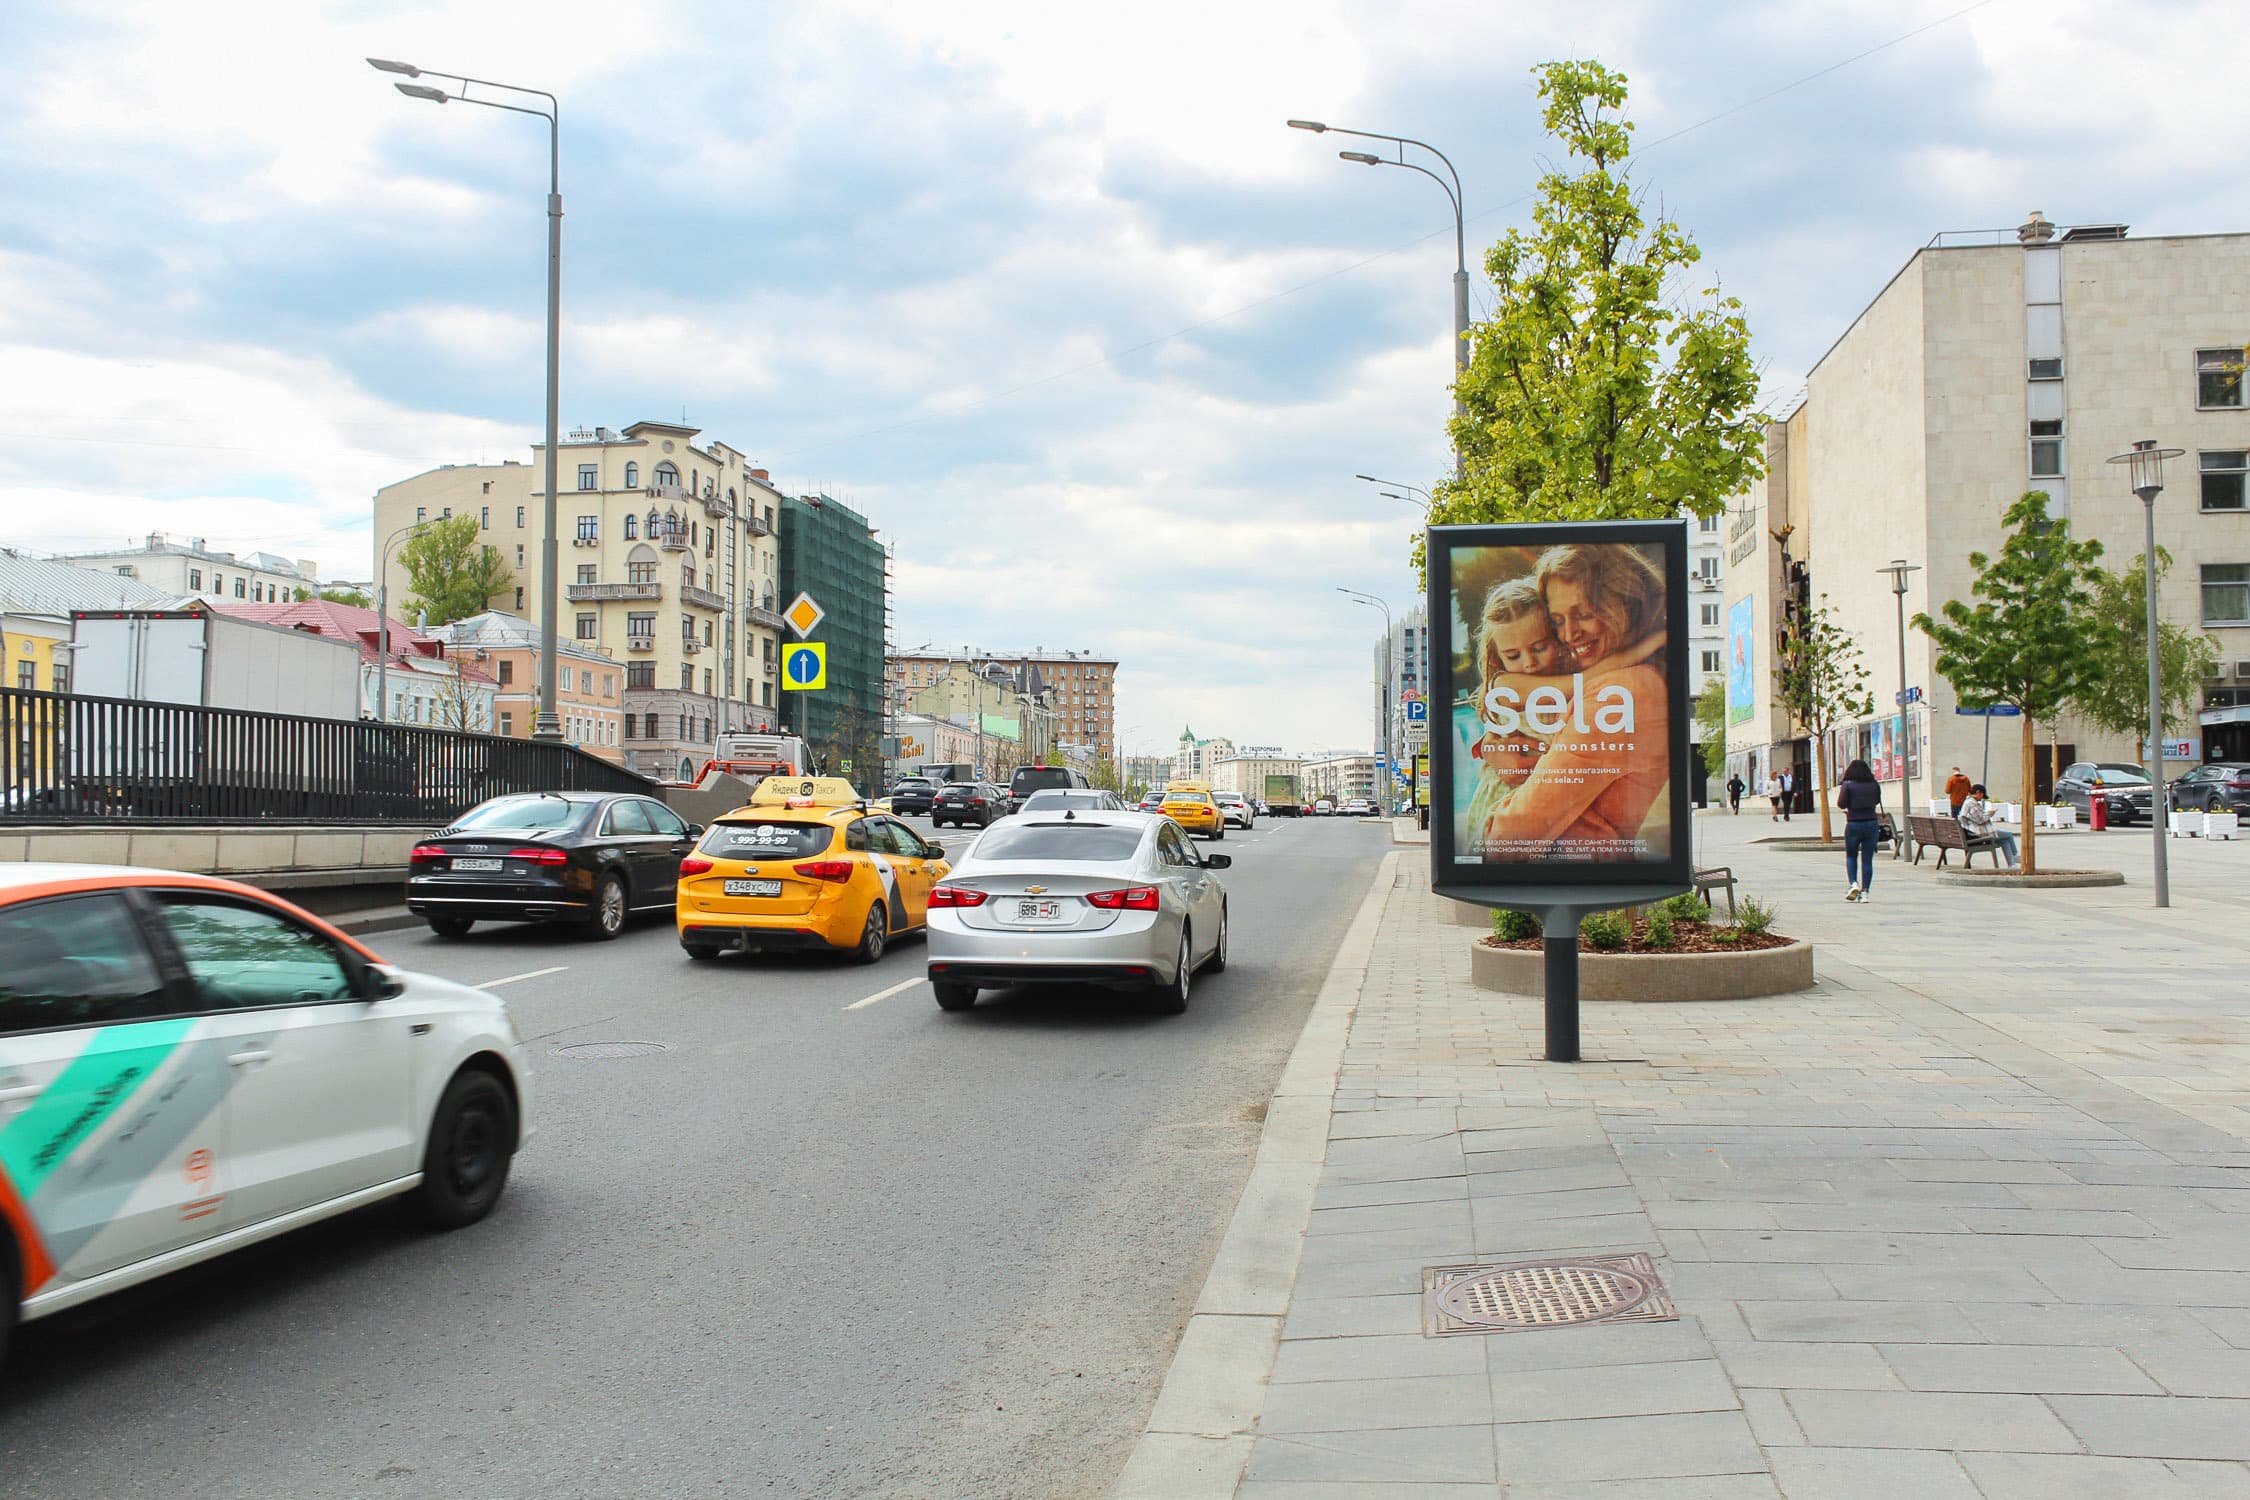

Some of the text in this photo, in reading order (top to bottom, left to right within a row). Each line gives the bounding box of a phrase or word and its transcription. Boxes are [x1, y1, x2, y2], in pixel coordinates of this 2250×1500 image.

[1484, 673, 1634, 734] sela
[1484, 741, 1635, 752] moms & monsters
[1554, 776, 1584, 784] sela.ru
[771, 783, 836, 795] Яндекс Go Такси
[737, 836, 789, 845] 999-99-99
[1021, 904, 1058, 916] 6919 JT
